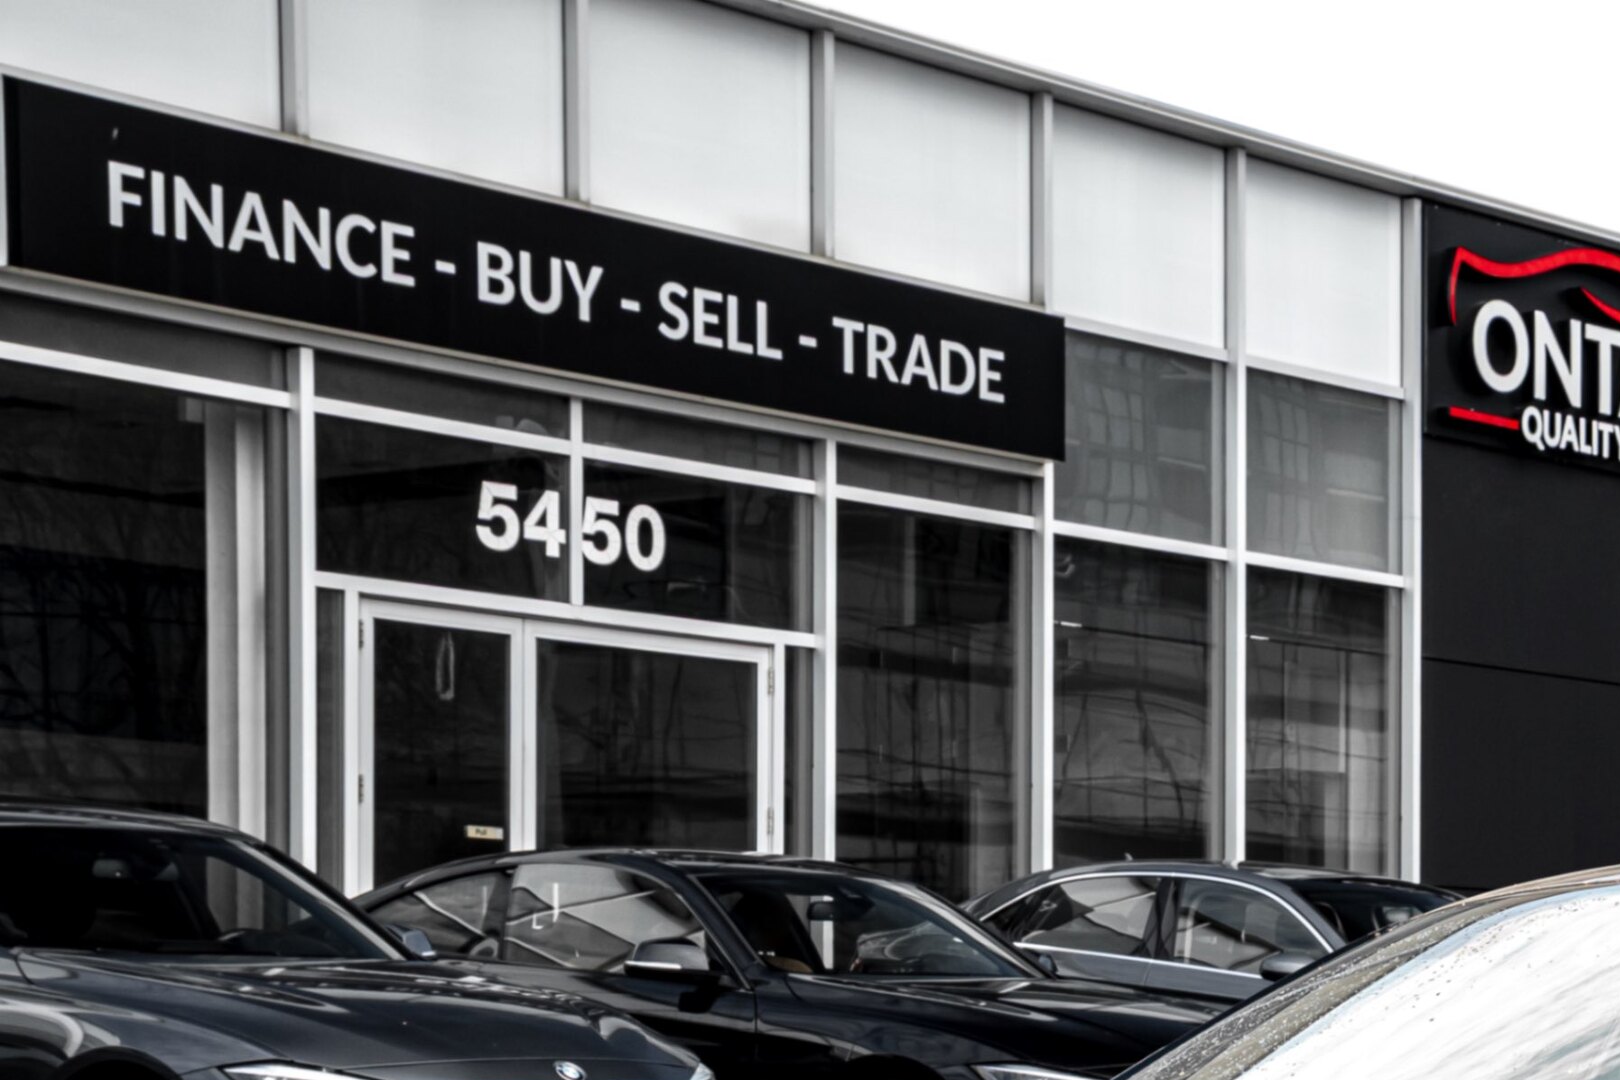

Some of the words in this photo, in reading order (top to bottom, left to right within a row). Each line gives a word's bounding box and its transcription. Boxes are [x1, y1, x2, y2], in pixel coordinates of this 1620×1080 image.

[108, 161, 415, 286] FINANCE
[477, 242, 603, 322] BUY
[659, 282, 782, 359] SELL
[833, 317, 1004, 403] TRADE
[476, 481, 666, 571] 5450
